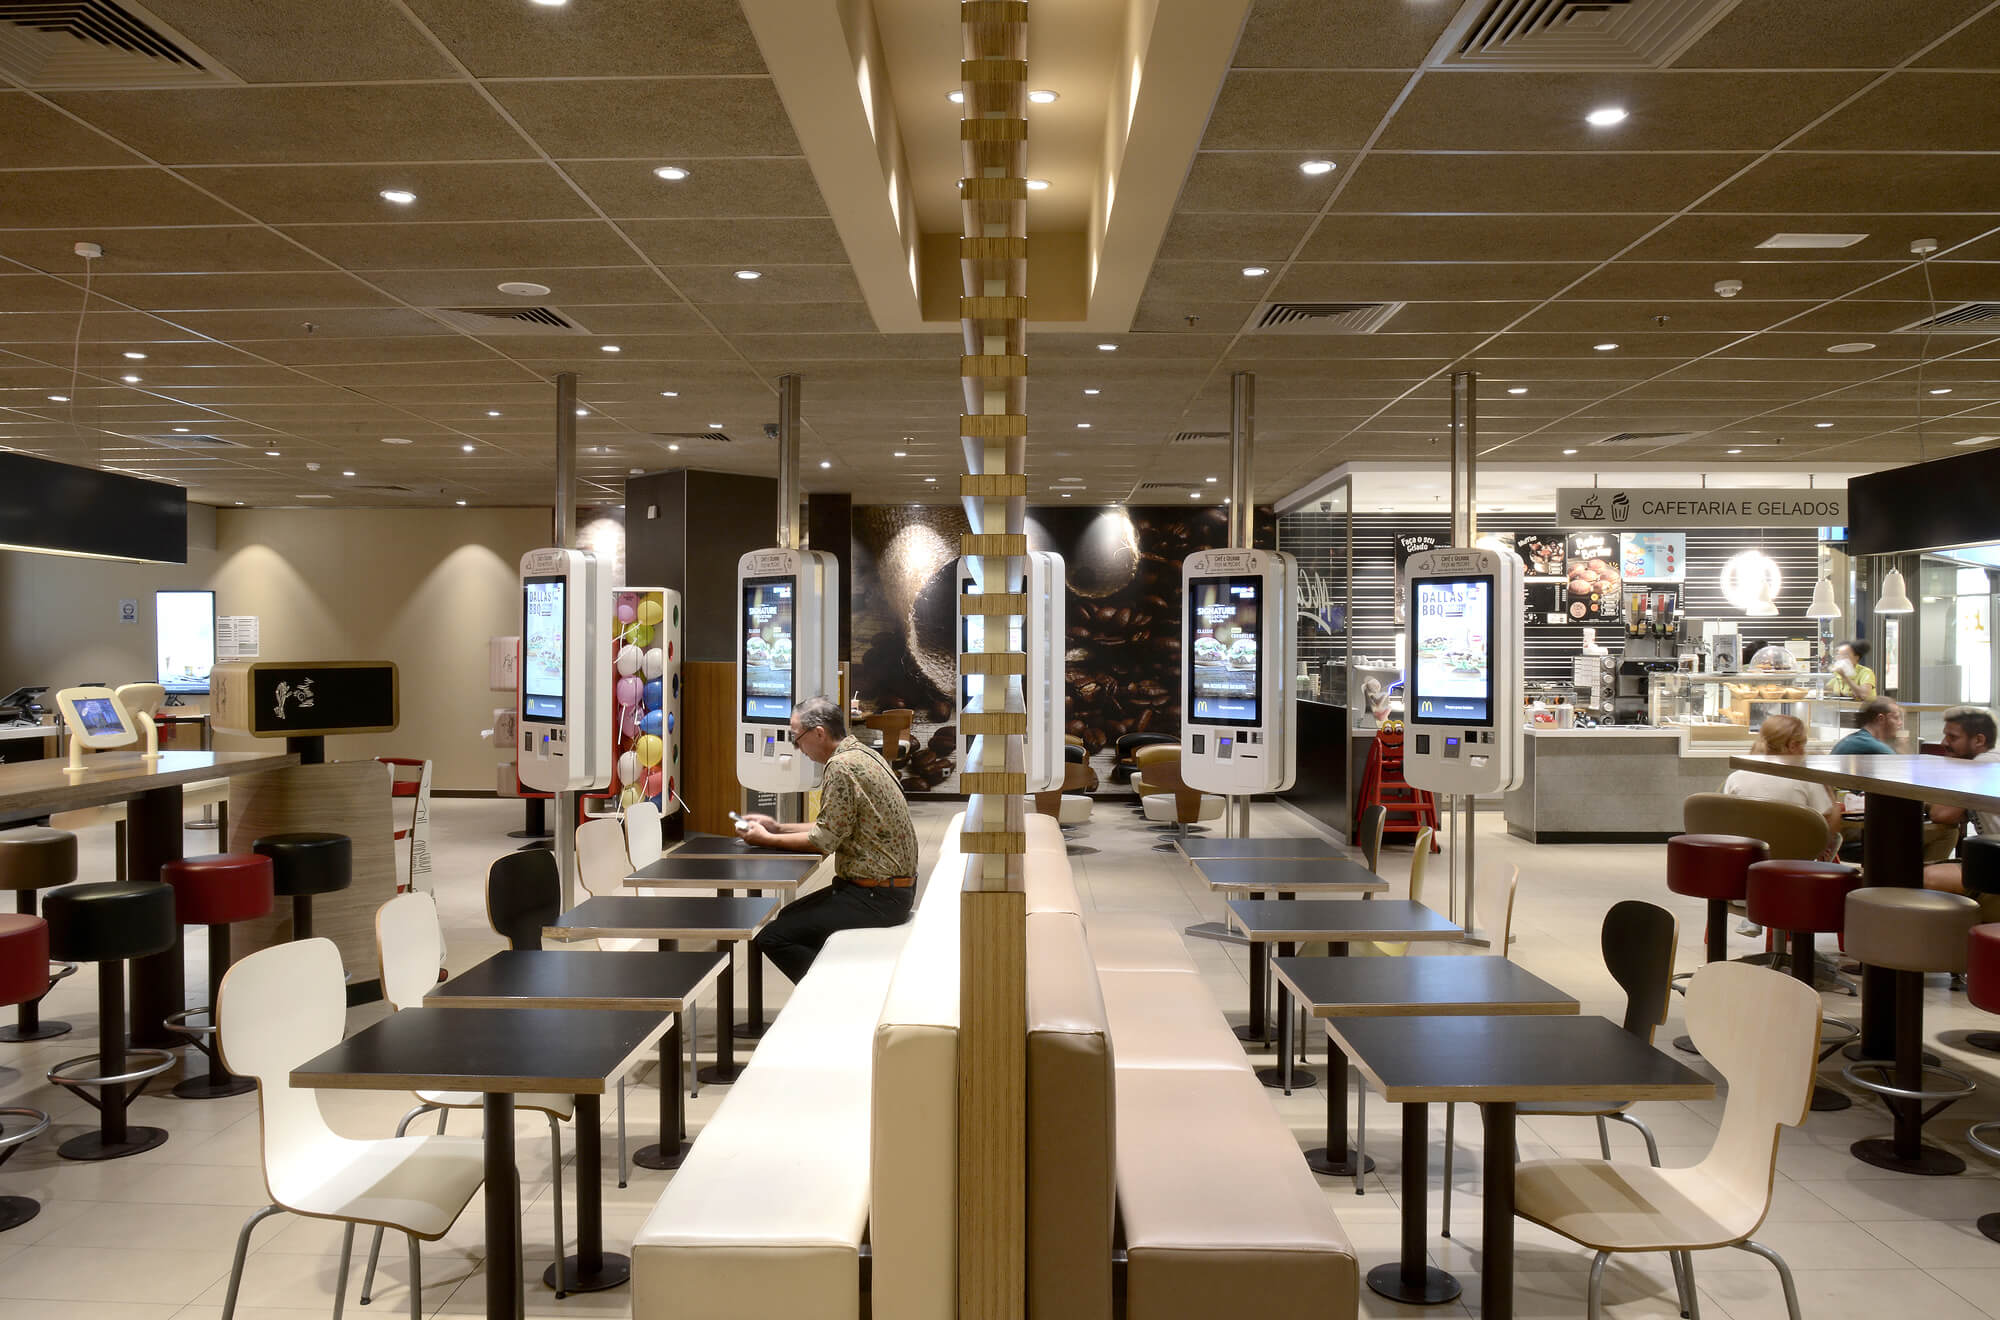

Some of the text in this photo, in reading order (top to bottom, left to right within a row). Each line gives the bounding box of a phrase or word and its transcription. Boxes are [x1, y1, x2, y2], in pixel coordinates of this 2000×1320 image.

[1642, 501, 1839, 516] CAFETARIA E GELADOS
[1401, 537, 1416, 546] Faça
[529, 591, 552, 602] DALLAS
[1422, 591, 1463, 603] DALLAS
[1197, 607, 1236, 615] SIGNATURE
[1422, 605, 1443, 617] BBQ
